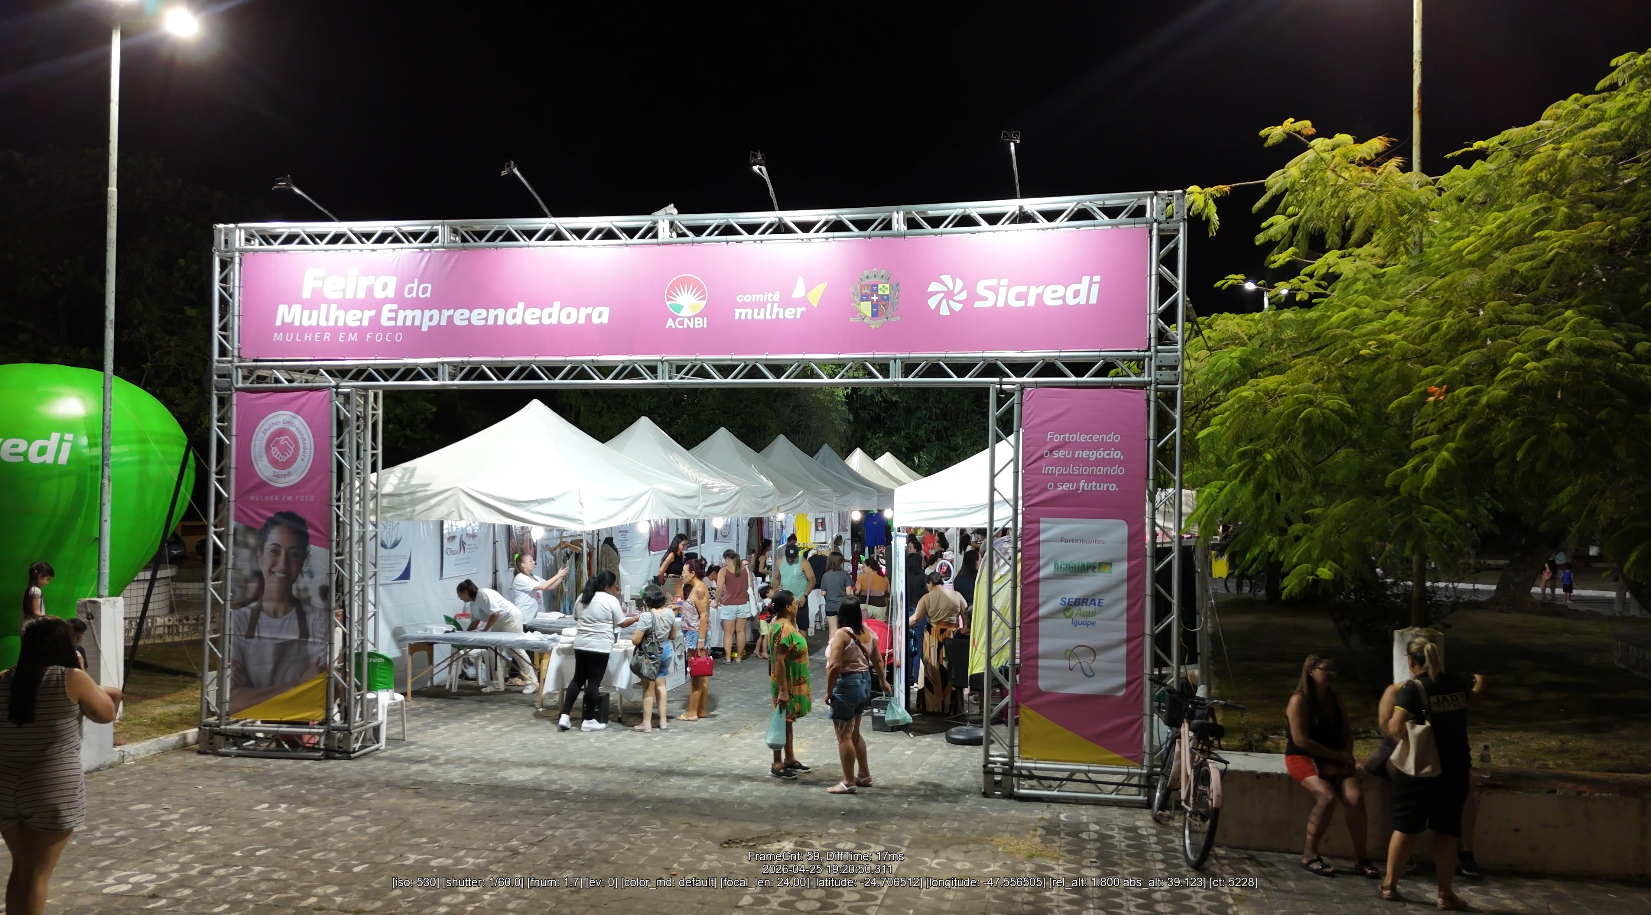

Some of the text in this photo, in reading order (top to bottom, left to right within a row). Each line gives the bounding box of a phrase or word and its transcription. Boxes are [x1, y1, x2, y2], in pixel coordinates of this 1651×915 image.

[302, 267, 432, 299] Feira da
[736, 290, 782, 303] comitê
[973, 275, 1101, 309] Sicredi
[275, 301, 611, 331] Mulher Empreendedora
[734, 304, 807, 321] mulher
[665, 317, 708, 329] ACNBI
[273, 332, 404, 342] MULHER EM FOCO
[1046, 431, 1121, 443] Fortalecendo
[0, 432, 74, 465] edi
[1043, 447, 1124, 461] o seu negócio,
[1042, 463, 1125, 476] impulsionando
[1057, 483, 1076, 491] seu
[1078, 479, 1119, 492] futuro.
[1060, 596, 1105, 607] SEBRAE
[1074, 608, 1097, 619] Aqui
[1071, 618, 1096, 627] Iguape
